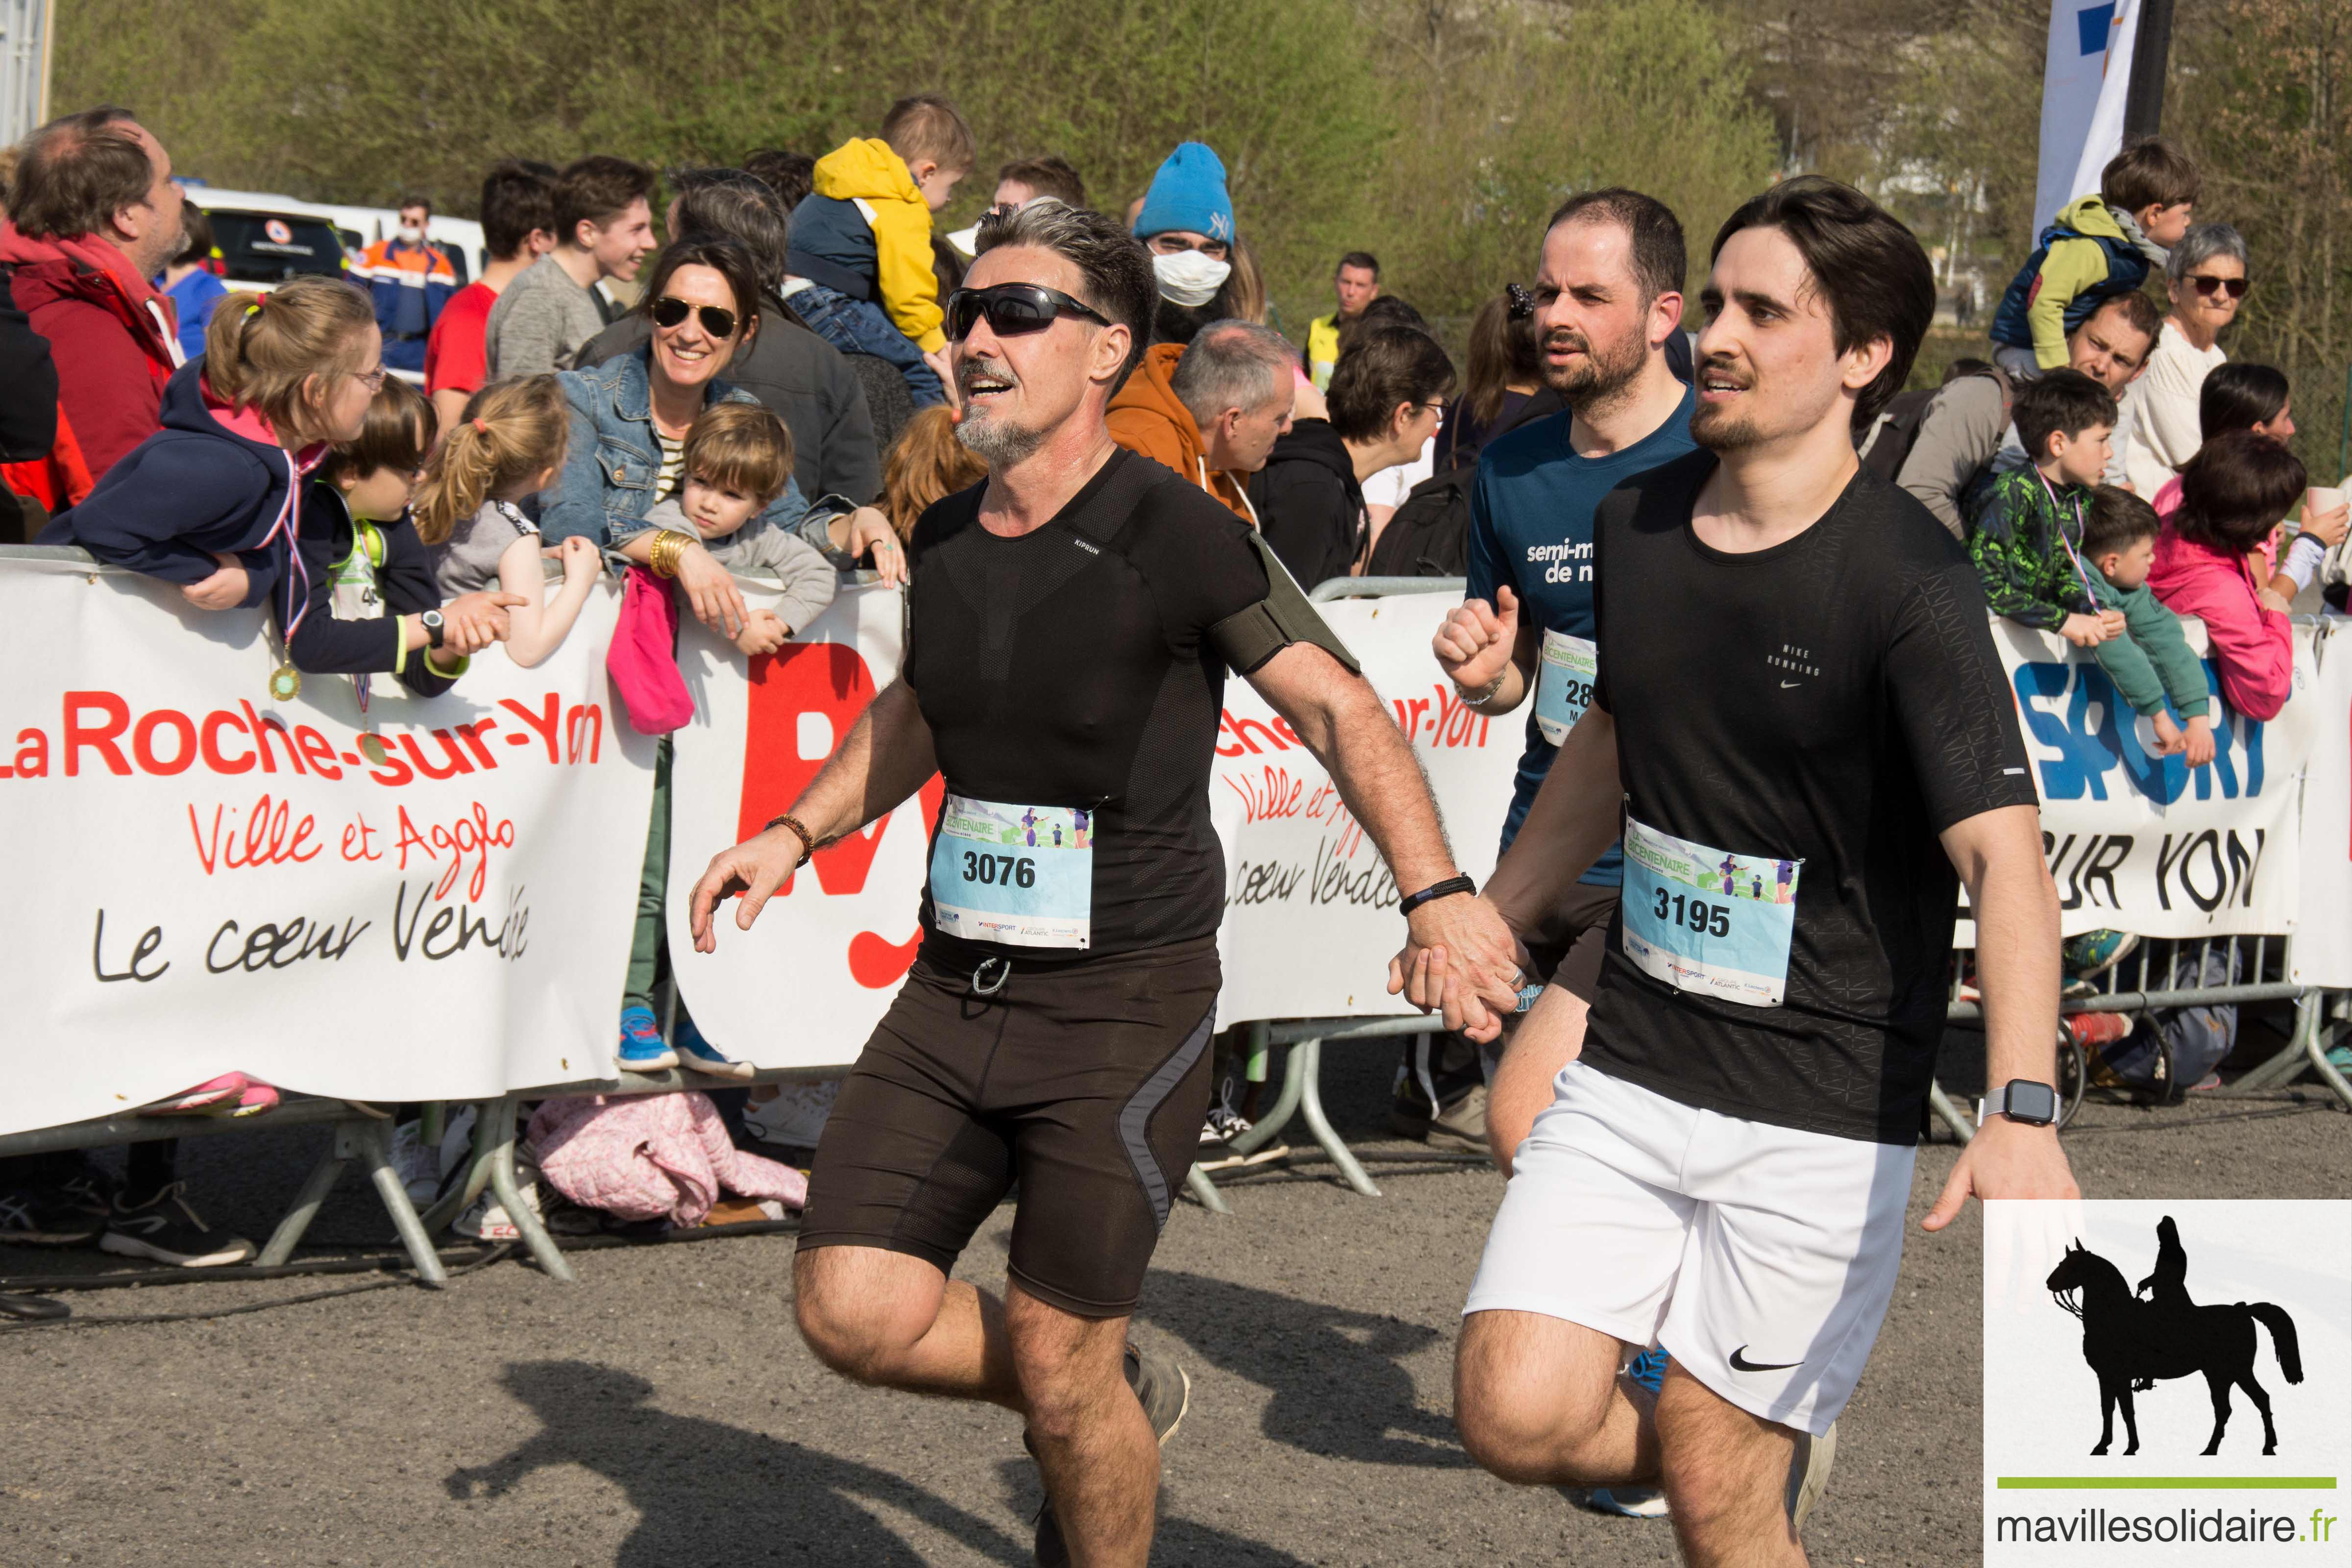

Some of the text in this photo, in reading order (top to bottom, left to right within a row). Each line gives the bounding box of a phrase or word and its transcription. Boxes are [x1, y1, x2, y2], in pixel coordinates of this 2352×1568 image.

[1075, 539, 1099, 555] KIPRUN
[1527, 538, 1593, 562] semi-m
[1545, 559, 1593, 583] de n
[362, 587, 377, 607] 4
[1544, 646, 1595, 669] BICENTENAIRE
[1783, 644, 1809, 659] NIKE
[1767, 655, 1819, 676] RUNNING
[1566, 679, 1592, 709] 28
[1222, 765, 1302, 825] Ville
[1306, 776, 1336, 818] et
[188, 793, 514, 903] Ville et Agglo
[1628, 839, 1690, 876] BICENTENAIRE
[963, 851, 1035, 888] 3076
[2042, 828, 2265, 913] UR YON
[1654, 887, 1730, 938] 3195
[983, 922, 1016, 931] INTERSPORT
[94, 907, 170, 982] Le
[1671, 964, 1706, 980] INTERSPORT
[1714, 981, 1740, 990] ATLANTIC
